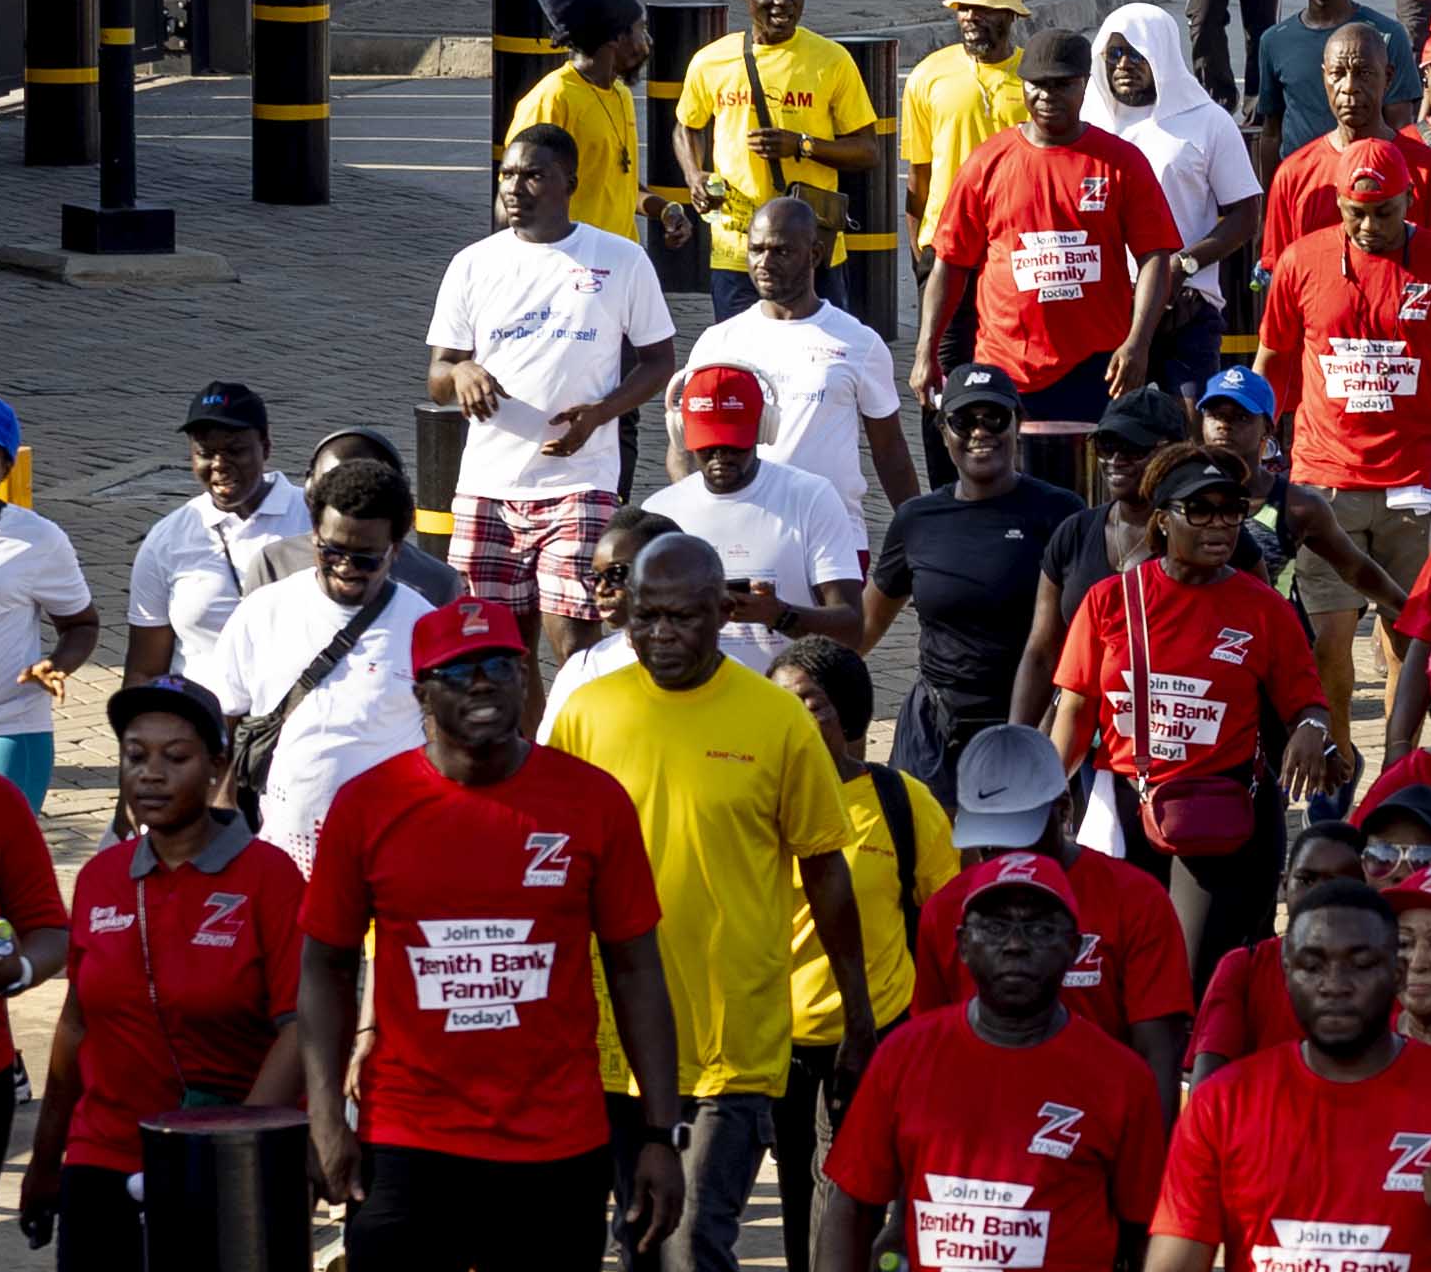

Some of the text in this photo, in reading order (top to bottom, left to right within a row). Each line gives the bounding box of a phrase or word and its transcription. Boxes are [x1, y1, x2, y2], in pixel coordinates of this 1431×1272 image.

[717, 92, 813, 109] ASHAM
[1059, 232, 1078, 244] the
[1014, 249, 1098, 269] Zenith Bank
[1033, 267, 1087, 285] Family
[1042, 286, 1080, 300] today!
[1324, 362, 1370, 377] Zenith
[1343, 379, 1400, 395] Family
[1351, 398, 1391, 412] today!
[1175, 679, 1197, 694] the
[1173, 704, 1219, 723] Bank
[524, 871, 567, 886] ZENITH
[191, 932, 237, 948] ZENITH
[442, 923, 516, 942] Join the
[417, 950, 548, 977] Zenith Bank
[441, 976, 524, 1005] Family
[451, 1011, 513, 1029] today!
[942, 1183, 1013, 1204] Join the
[918, 1212, 1043, 1239] Zenith Bank
[1294, 1228, 1371, 1247] Join the
[935, 1239, 1018, 1266] Family
